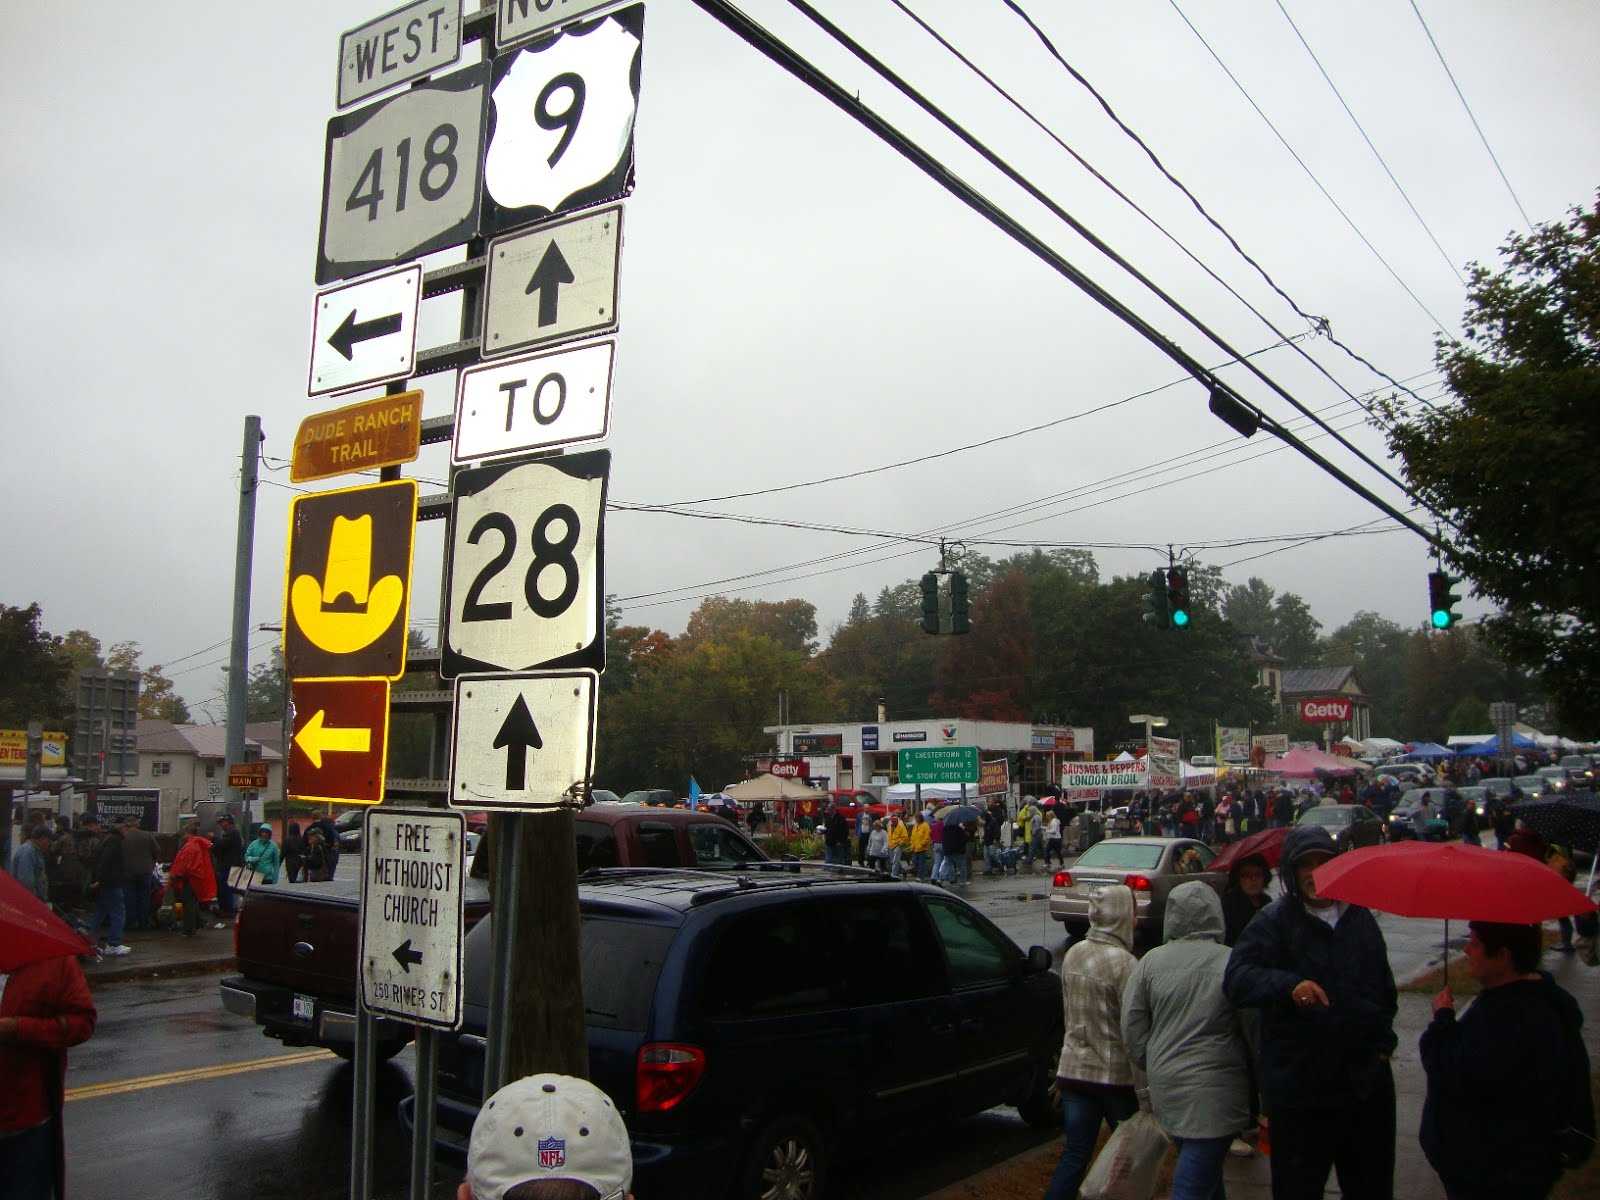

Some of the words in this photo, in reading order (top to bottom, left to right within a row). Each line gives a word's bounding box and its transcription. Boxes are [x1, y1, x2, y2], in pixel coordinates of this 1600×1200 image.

[356, 8, 445, 83] WEST
[534, 72, 586, 170] 9
[345, 123, 458, 221] 418
[499, 372, 566, 432] TO
[305, 419, 346, 443] DUDE
[354, 404, 413, 433] RANCH
[331, 439, 378, 463] TRAIL
[461, 503, 581, 623] 28
[1304, 703, 1348, 718] Getty
[915, 751, 960, 759] CHESTERTOWN
[965, 750, 971, 758] 12
[933, 761, 964, 769] THURMAN
[772, 764, 799, 776] Getty
[1063, 764, 1099, 775] SAUSAGE
[1102, 764, 1108, 774] &
[1110, 762, 1146, 773] PEPPERS
[1070, 774, 1108, 786] LONDON
[1111, 774, 1138, 785] BROIL
[210, 787, 220, 795] 30
[232, 777, 251, 785] MAIN
[97, 803, 144, 817] Warrensburg
[396, 824, 431, 852] FREE
[374, 858, 452, 892] METHODIST
[384, 894, 438, 927] CHURCH
[373, 982, 389, 1000] 250
[392, 983, 425, 1008] RIVER
[540, 1150, 563, 1167] NFL
